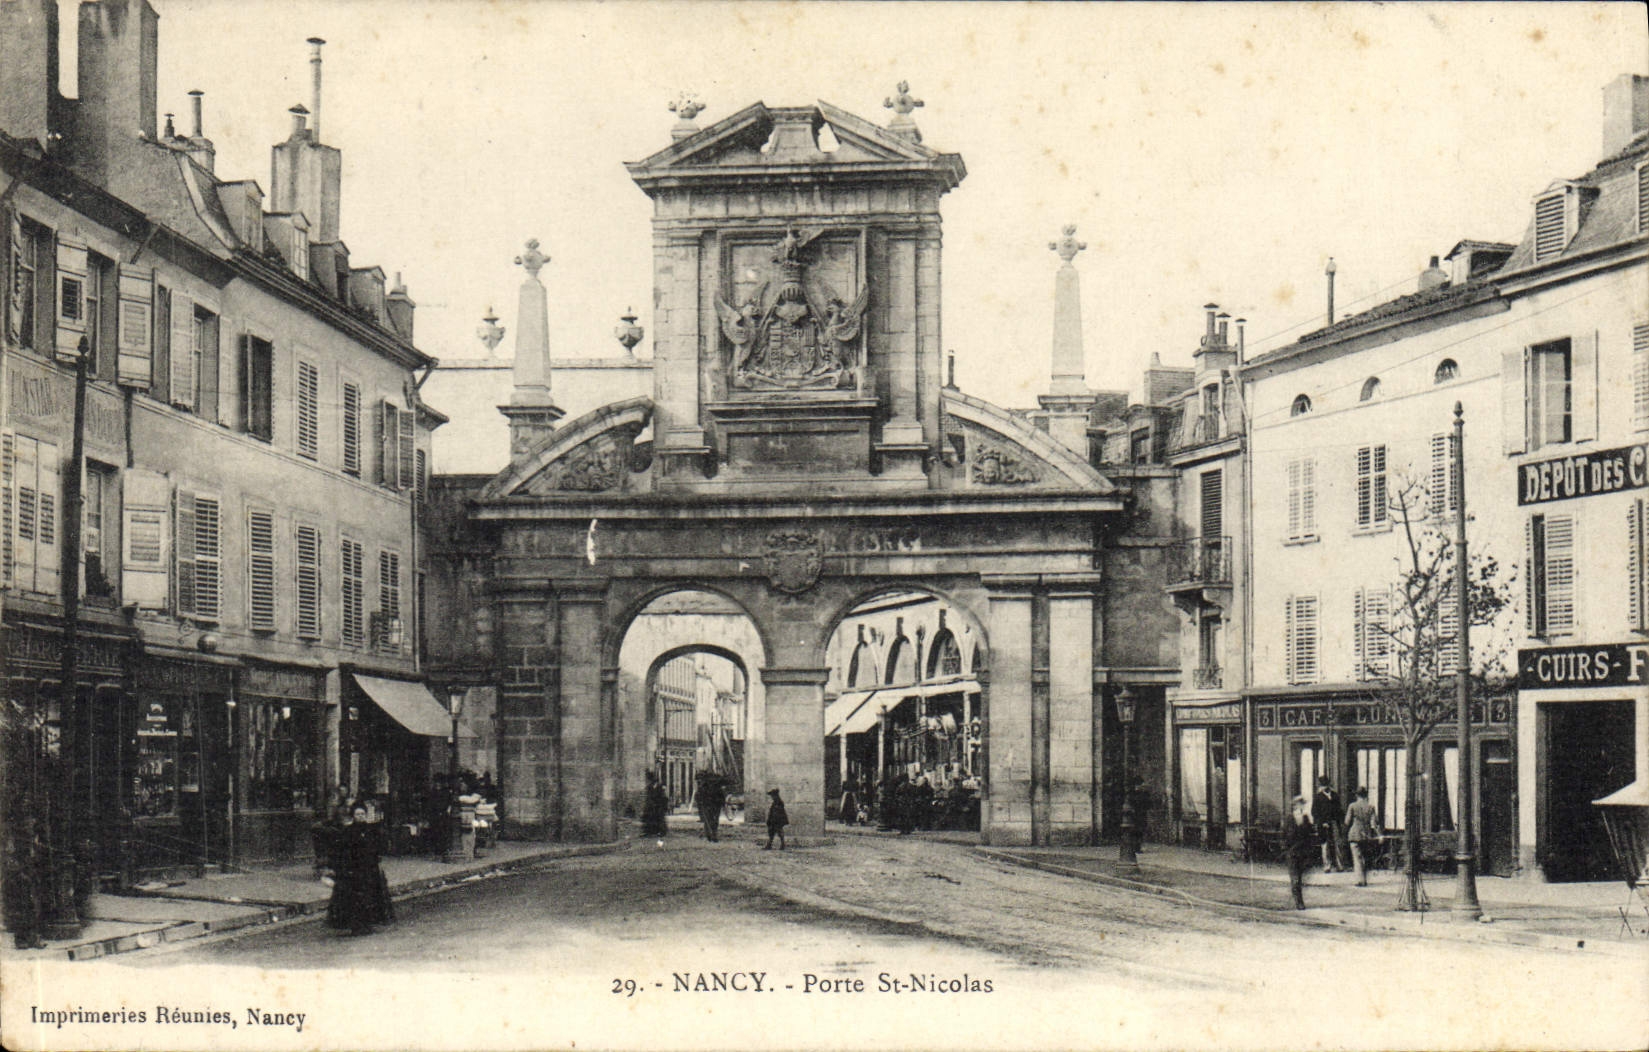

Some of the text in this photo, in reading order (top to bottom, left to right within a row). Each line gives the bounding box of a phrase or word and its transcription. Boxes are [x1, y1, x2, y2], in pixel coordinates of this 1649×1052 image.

[1591, 457, 1625, 492] DES
[1629, 445, 1649, 487] C
[1537, 650, 1609, 682] CUIRS
